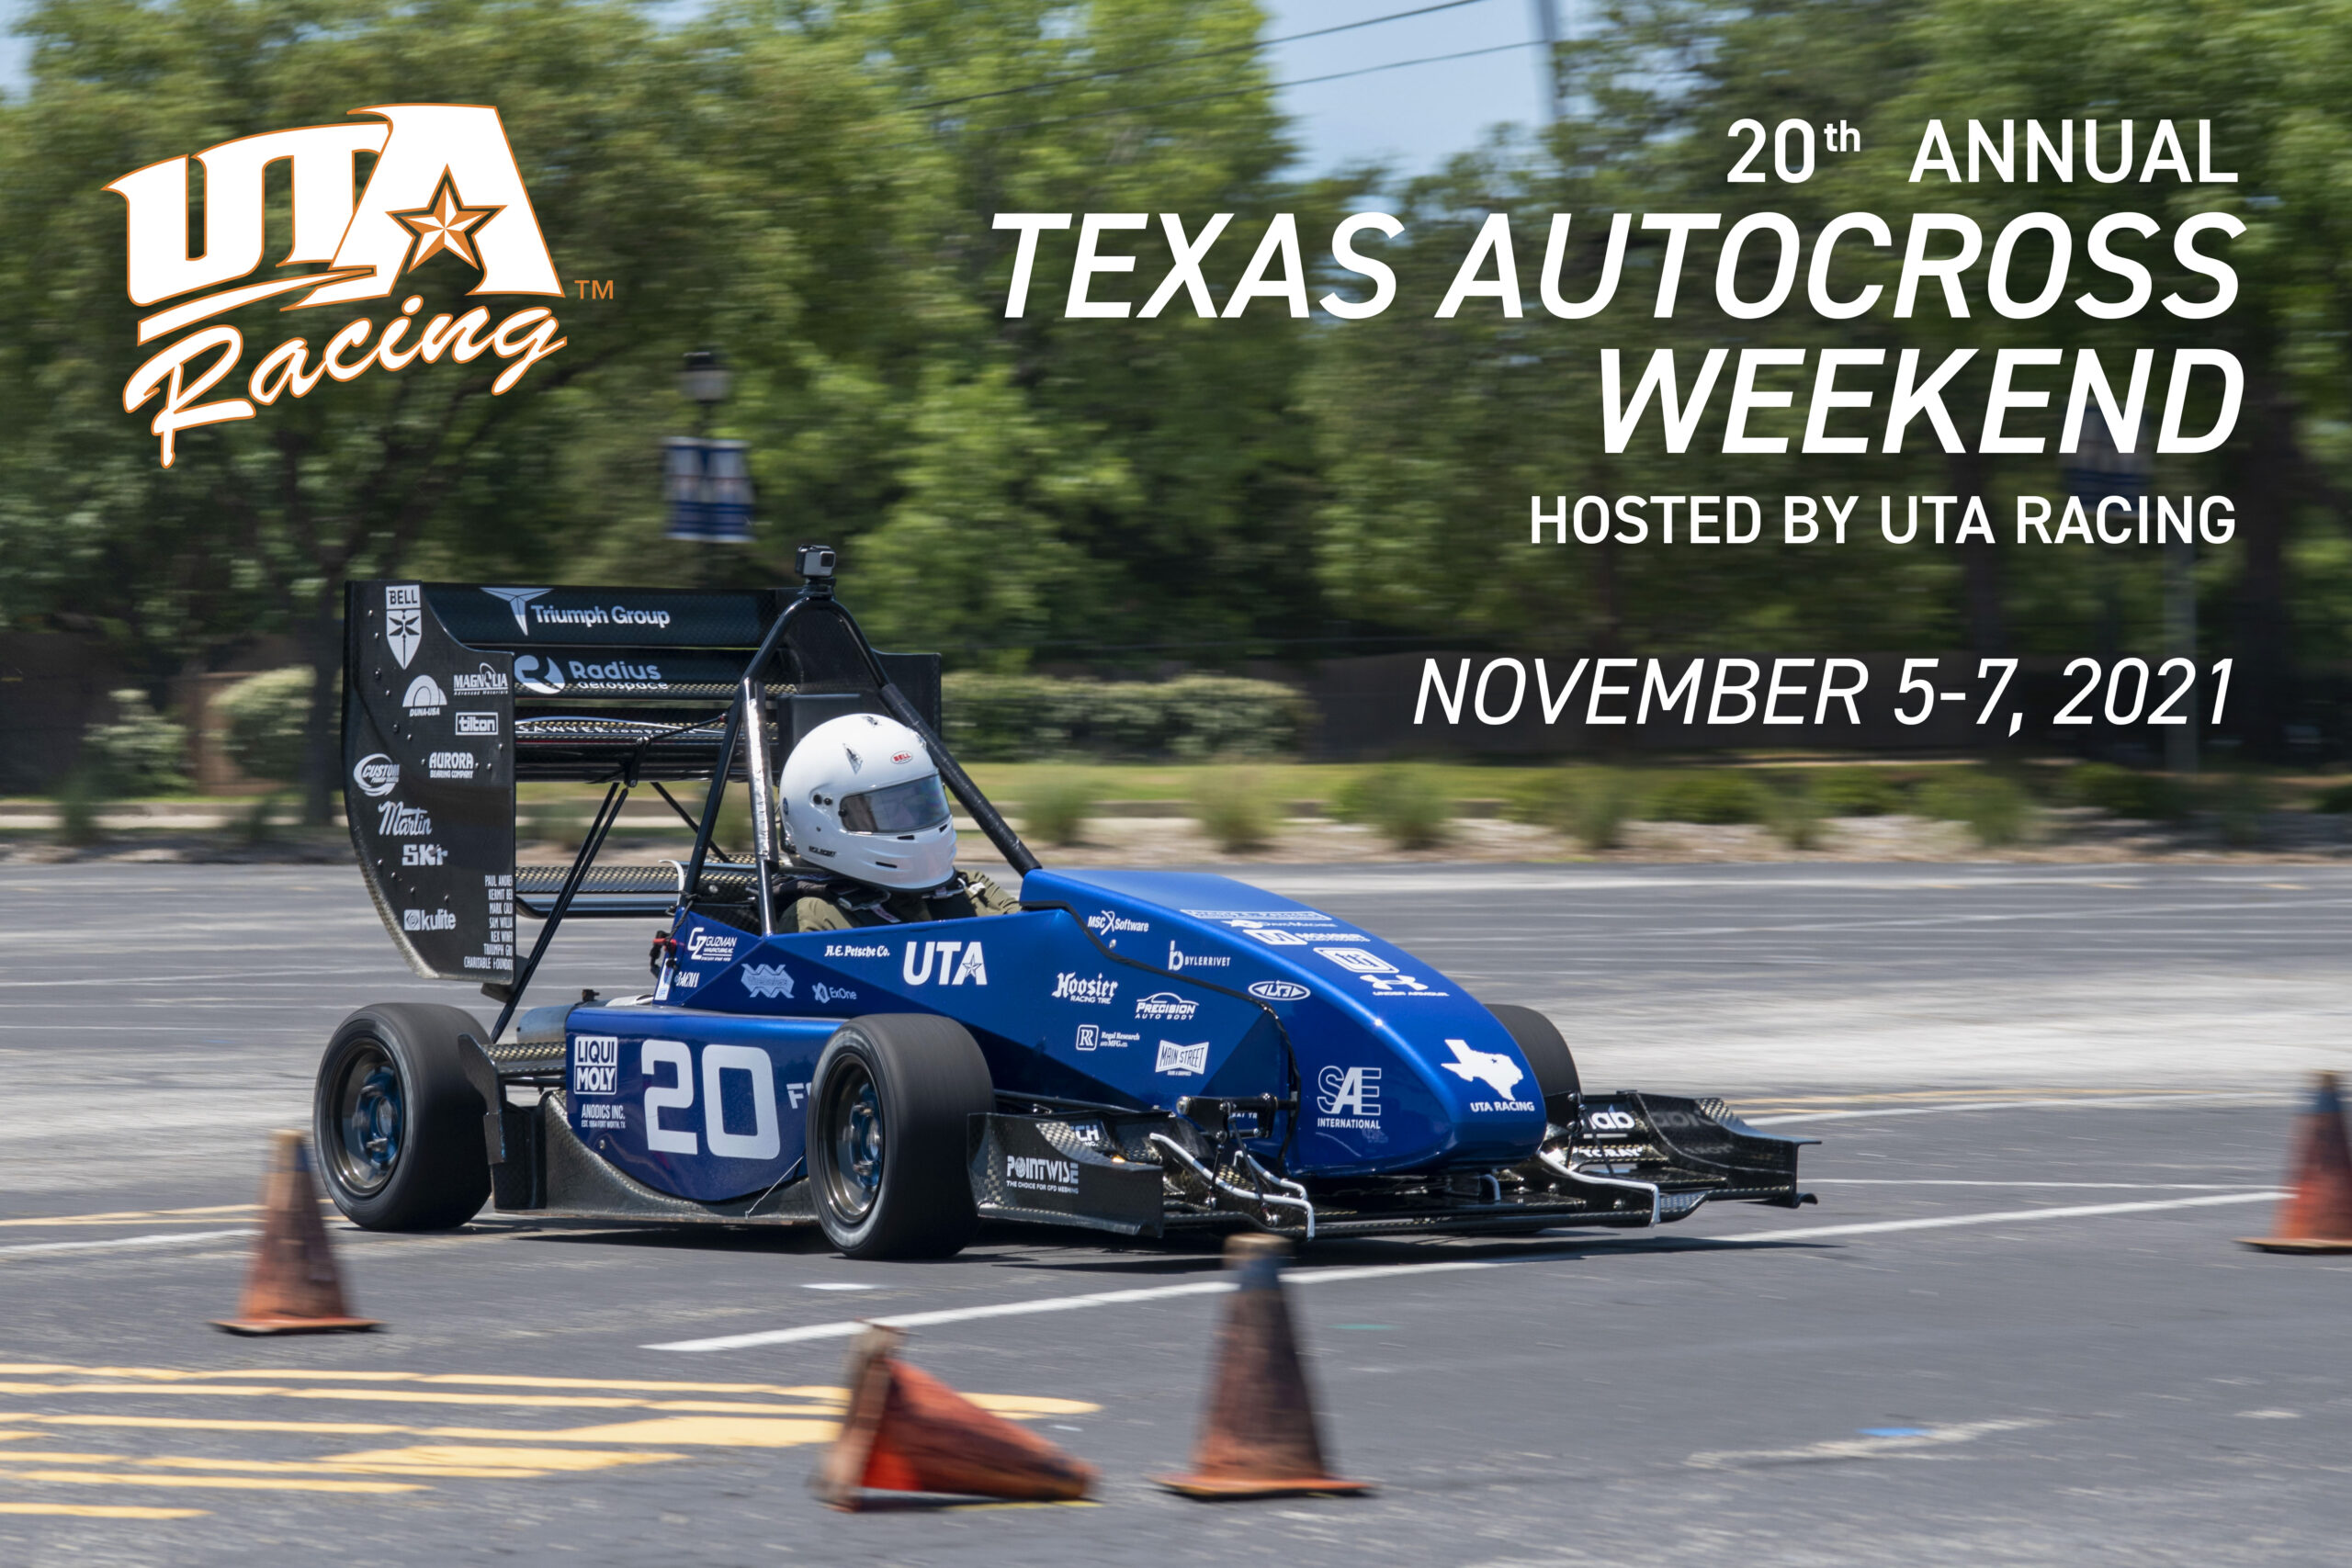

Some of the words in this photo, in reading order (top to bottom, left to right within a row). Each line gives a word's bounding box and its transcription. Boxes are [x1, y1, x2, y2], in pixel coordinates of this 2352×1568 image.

[389, 590, 418, 605] BELL
[530, 604, 608, 628] Triumph
[611, 604, 671, 628] Group
[568, 660, 662, 681] Radius
[453, 672, 508, 688] MAGNOLIA
[578, 681, 669, 691] aerospace
[458, 716, 496, 732] tilton
[428, 751, 474, 770] AURORA
[893, 751, 912, 761] BELL
[362, 763, 400, 778] CUSTOM
[378, 800, 433, 836] Martin
[421, 908, 457, 931] kulite
[706, 935, 738, 948] GUZMAN
[902, 941, 989, 987] UTA
[1051, 971, 1119, 998] Hoosier
[829, 987, 857, 1000] ExOne
[1070, 995, 1095, 1003] RACING
[1098, 997, 1112, 1005] TIRE
[1136, 1002, 1196, 1015] PRECISION
[578, 1040, 615, 1064] LIQUI
[1159, 1045, 1178, 1068] MAIN
[1179, 1046, 1204, 1069] STREET
[576, 1066, 616, 1092] MOLY
[1317, 1065, 1382, 1116] SAE
[641, 1039, 781, 1160] 20
[1470, 1101, 1490, 1112] UTA
[1495, 1100, 1535, 1112] RACING
[581, 1103, 611, 1119] ANODICS
[1317, 1117, 1381, 1130] INTERNATIONAL
[1006, 1155, 1079, 1185] POINTWISE
[1017, 1181, 1035, 1190] CHOICE
